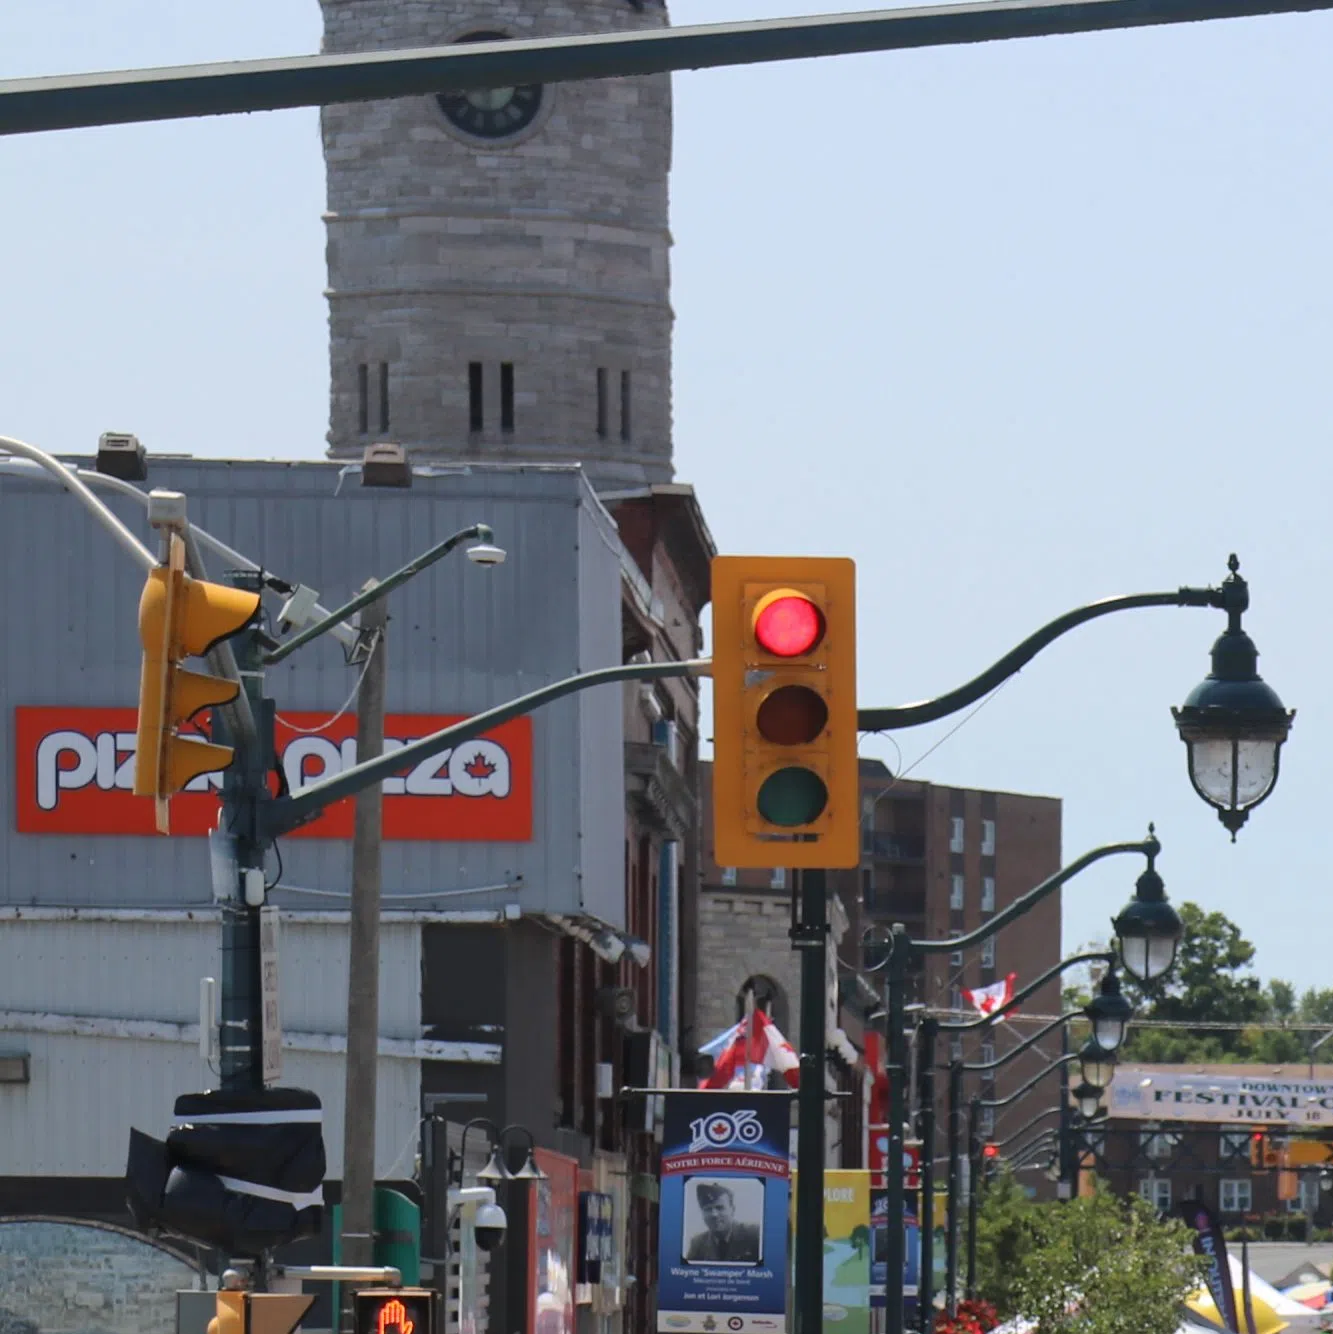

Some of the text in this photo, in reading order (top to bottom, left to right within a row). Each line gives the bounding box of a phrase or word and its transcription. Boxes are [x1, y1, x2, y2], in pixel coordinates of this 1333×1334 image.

[1154, 1090, 1308, 1109] FESTIVAL
[1230, 1108, 1289, 1120] JULY
[665, 1158, 700, 1172] NOTRE
[701, 1156, 733, 1167] FORCE
